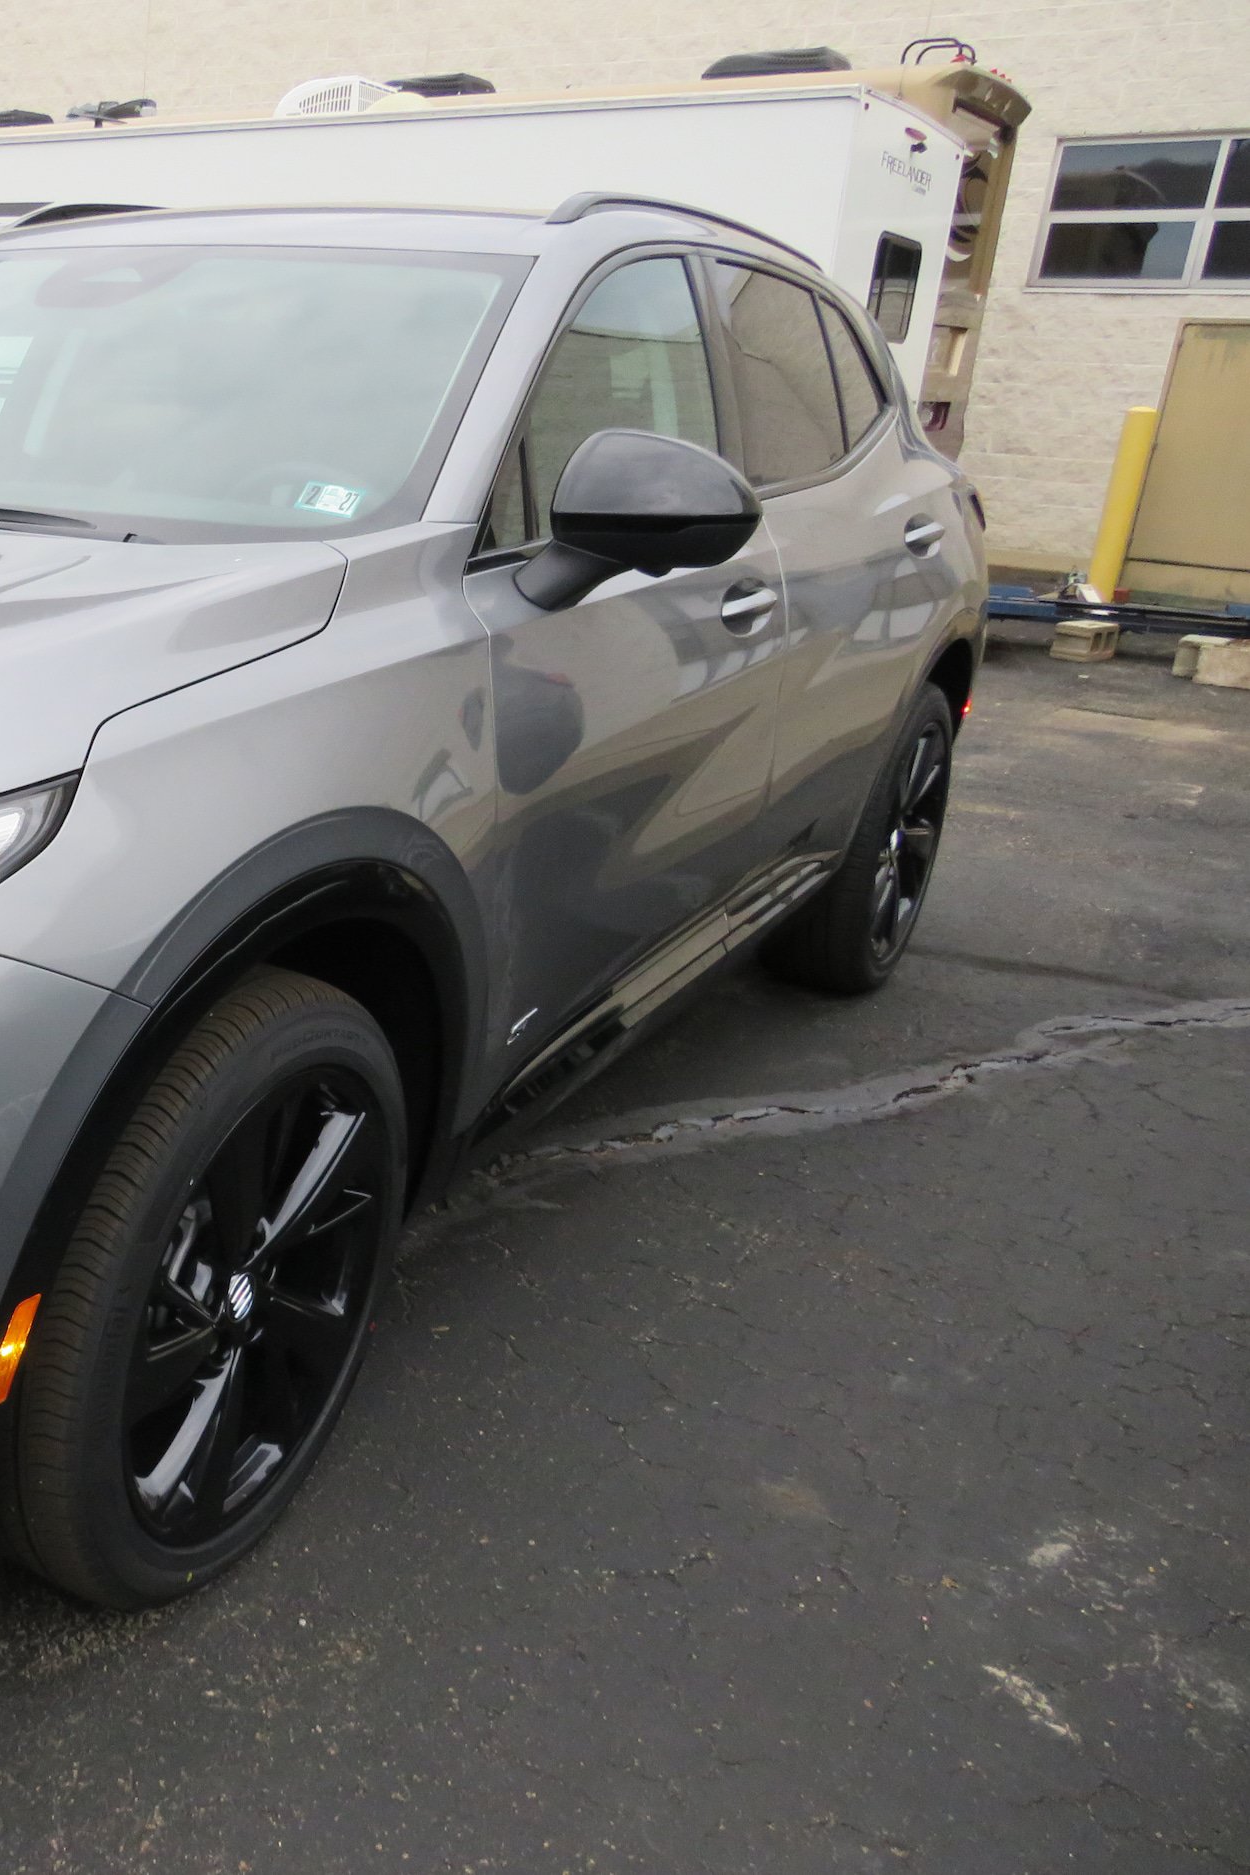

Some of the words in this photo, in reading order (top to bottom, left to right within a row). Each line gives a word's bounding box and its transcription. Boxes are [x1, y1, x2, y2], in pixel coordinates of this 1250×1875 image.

[880, 150, 932, 191] FREELANDER
[304, 485, 322, 506] 2
[338, 492, 360, 512] 27
